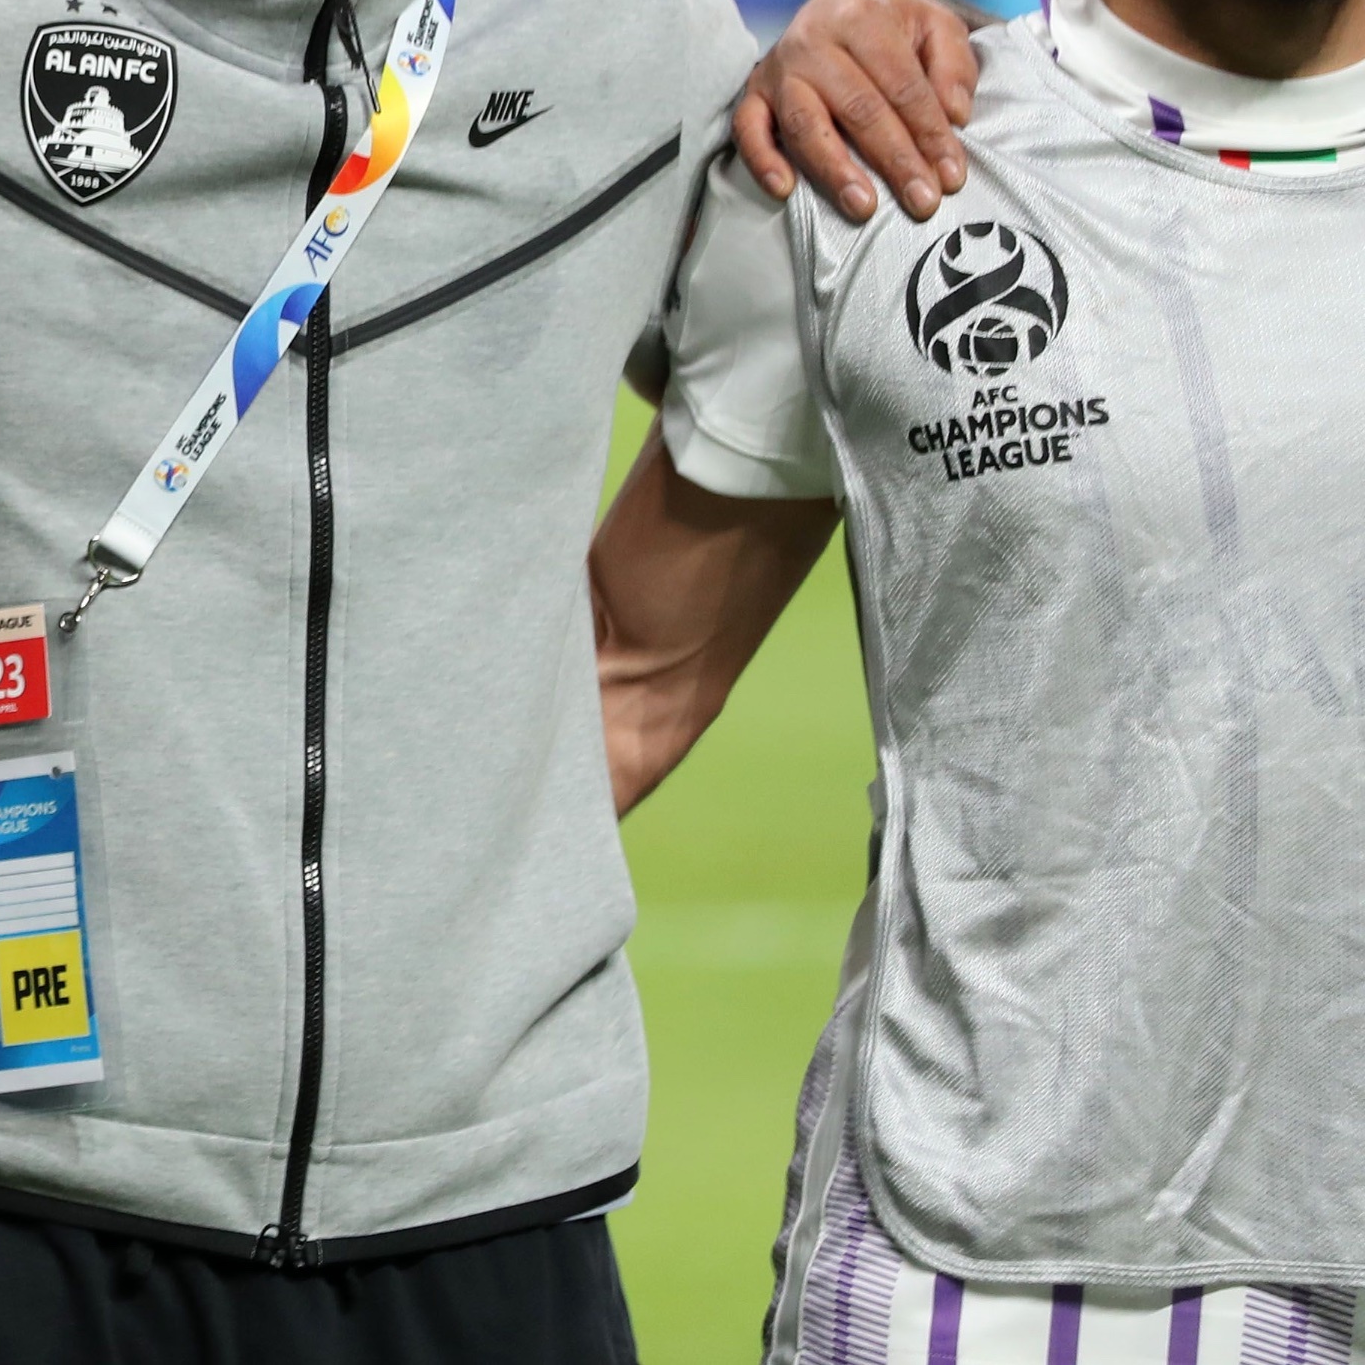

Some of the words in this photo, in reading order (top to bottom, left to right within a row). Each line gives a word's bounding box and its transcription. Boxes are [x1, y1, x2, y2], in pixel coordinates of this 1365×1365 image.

[45, 48, 77, 74] AL
[79, 53, 123, 80] AIN
[124, 58, 158, 84] FC
[481, 90, 535, 122] NIKE
[70, 174, 100, 189] 1968
[303, 205, 350, 277] AFC
[972, 385, 1018, 409] AFC
[908, 397, 1110, 454] CHAMPIONS
[943, 434, 1073, 482] LEAGUE
[13, 964, 70, 1011] PRE
